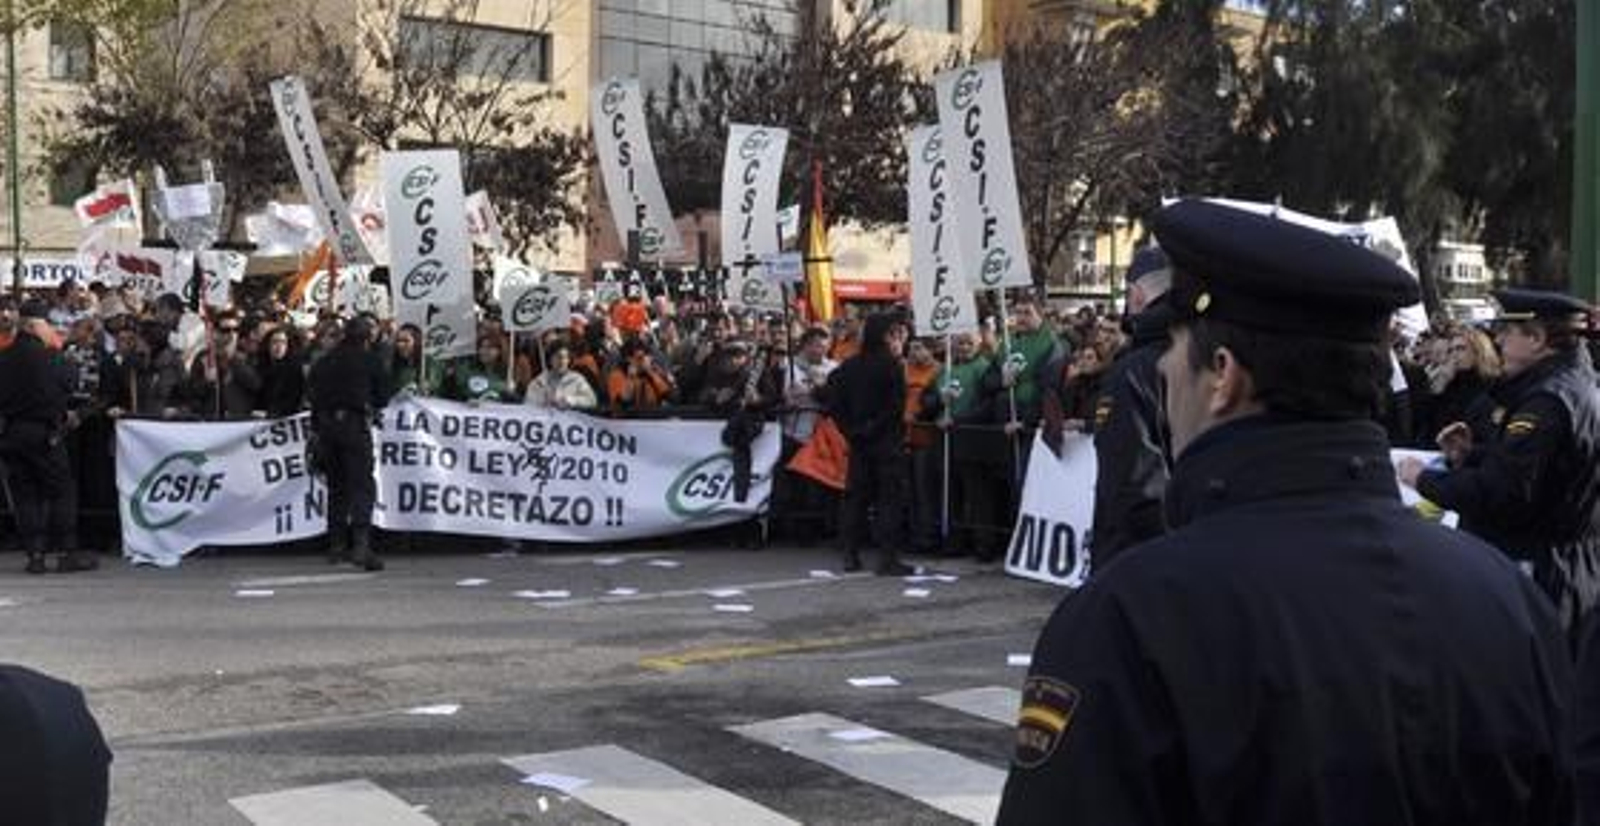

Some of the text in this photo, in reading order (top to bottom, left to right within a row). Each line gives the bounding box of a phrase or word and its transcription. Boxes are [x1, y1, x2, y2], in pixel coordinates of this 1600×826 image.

[396, 410, 430, 433] LA
[442, 415, 637, 455] DEROGACION
[262, 455, 304, 484] DE
[468, 450, 525, 477] LEY
[304, 489, 324, 520] N
[399, 482, 594, 527] DECRETAZO
